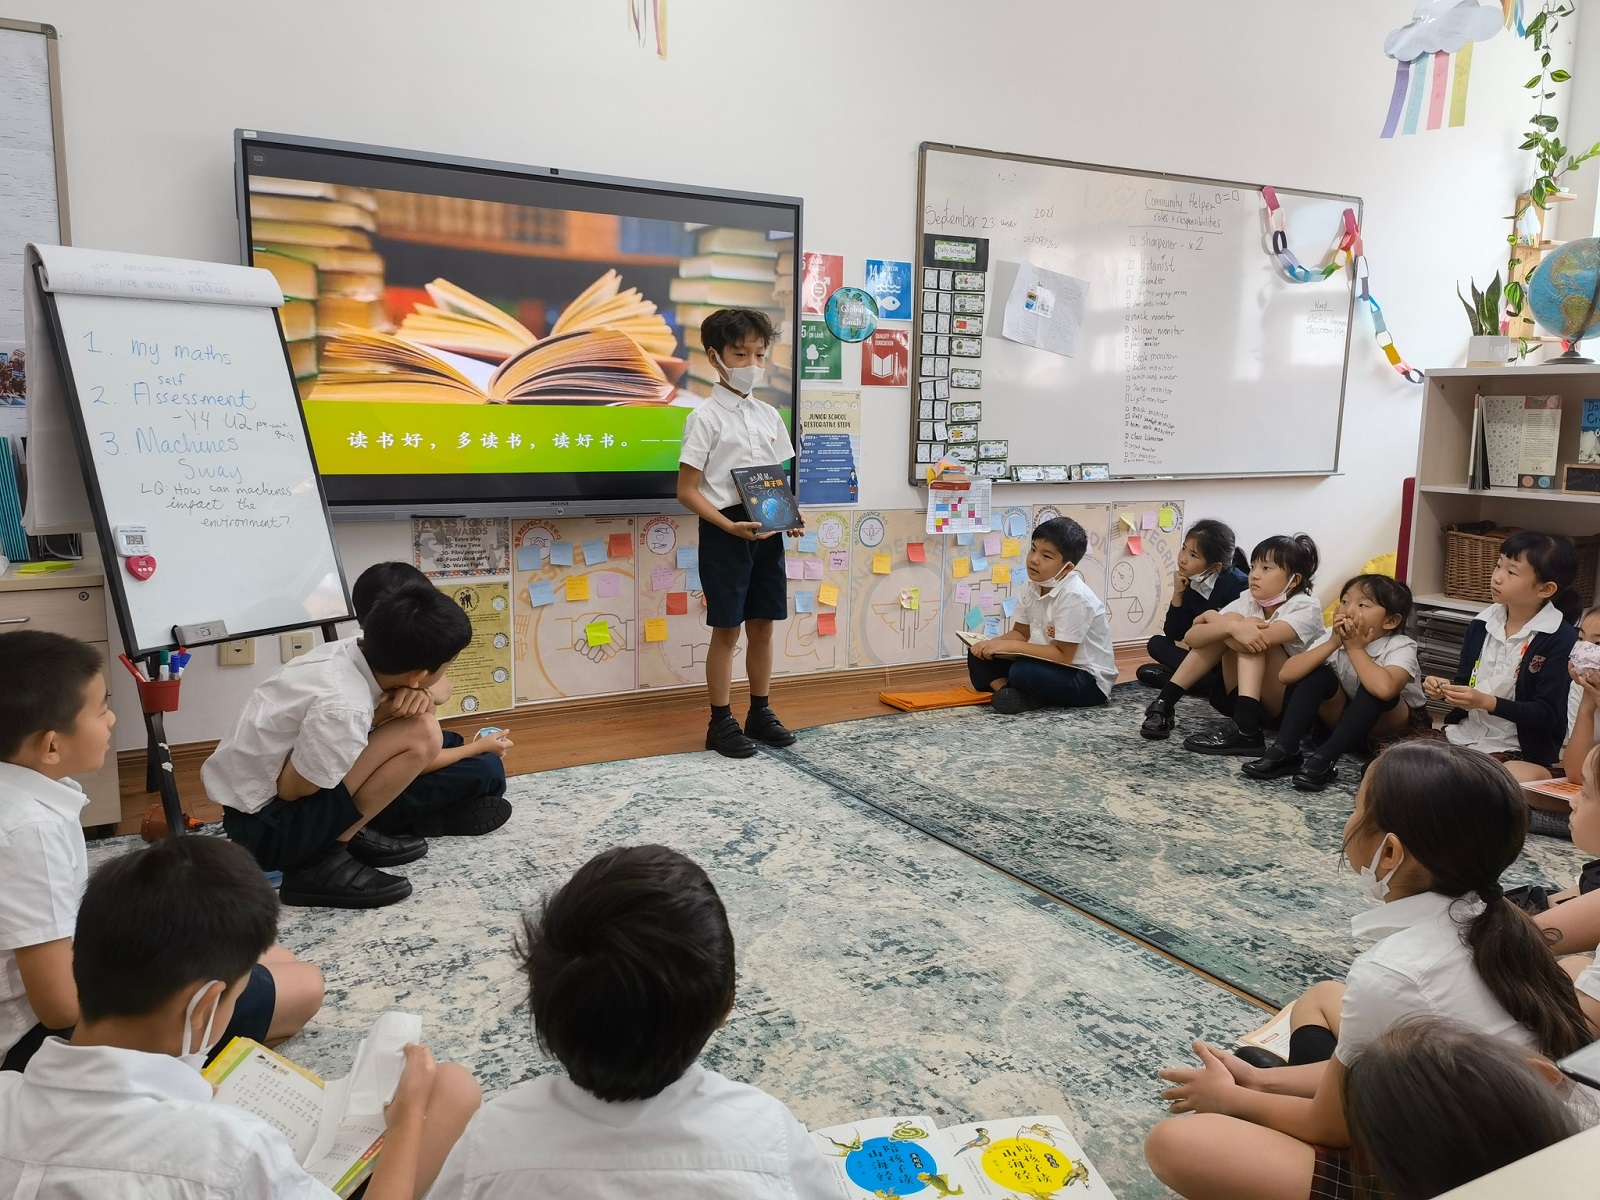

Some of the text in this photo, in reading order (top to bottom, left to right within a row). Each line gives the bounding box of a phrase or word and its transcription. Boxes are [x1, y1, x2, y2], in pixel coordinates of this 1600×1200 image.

[1145, 189, 1183, 212] Community
[926, 198, 979, 230] September
[982, 217, 995, 228] 23
[937, 246, 972, 256] Daily Schedule
[841, 304, 864, 314] Global
[842, 317, 862, 327] Goals
[174, 344, 232, 365] maths
[1132, 351, 1149, 362] Book
[157, 372, 187, 386] self
[133, 381, 257, 410] Assessment
[803, 421, 851, 429] RESTORATIVE STEPS
[136, 427, 240, 455] Machines
[178, 458, 243, 484] Sway
[173, 483, 202, 496] How
[208, 485, 231, 494] can
[235, 482, 292, 497] machines
[165, 496, 257, 514] impact the
[200, 514, 292, 530] environment?
[517, 518, 543, 537] RESPECT
[642, 516, 670, 533] KINDNESS
[825, 511, 850, 530] RESILIENCE
[853, 511, 881, 533] CONFIDENCE
[469, 536, 482, 544] play
[450, 549, 487, 557] Film/popcorn
[470, 561, 485, 569] Fight
